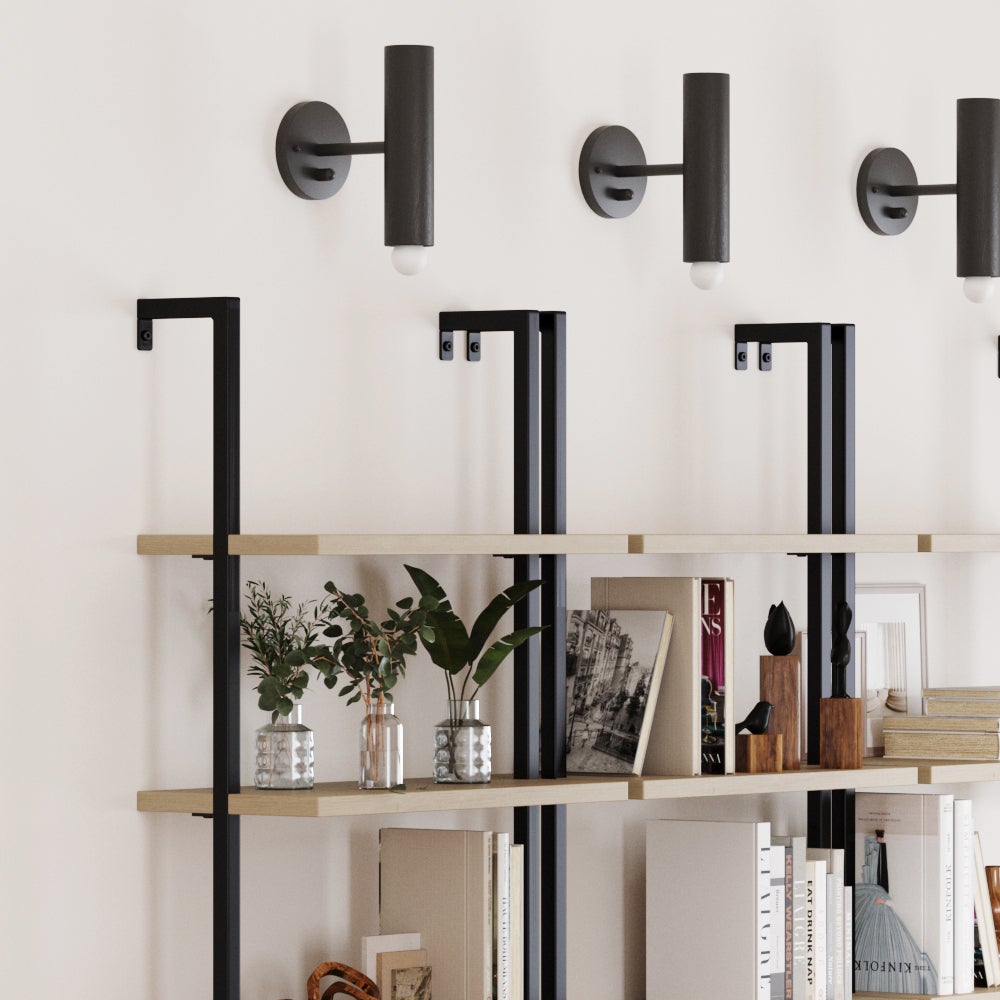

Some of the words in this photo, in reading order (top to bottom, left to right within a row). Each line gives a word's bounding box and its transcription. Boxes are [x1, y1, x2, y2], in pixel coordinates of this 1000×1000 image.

[785, 854, 793, 902] KELLY
[944, 864, 953, 922] KINFOLK
[785, 904, 793, 1000] WEARSTLER
[854, 960, 913, 974] KINFOLK
